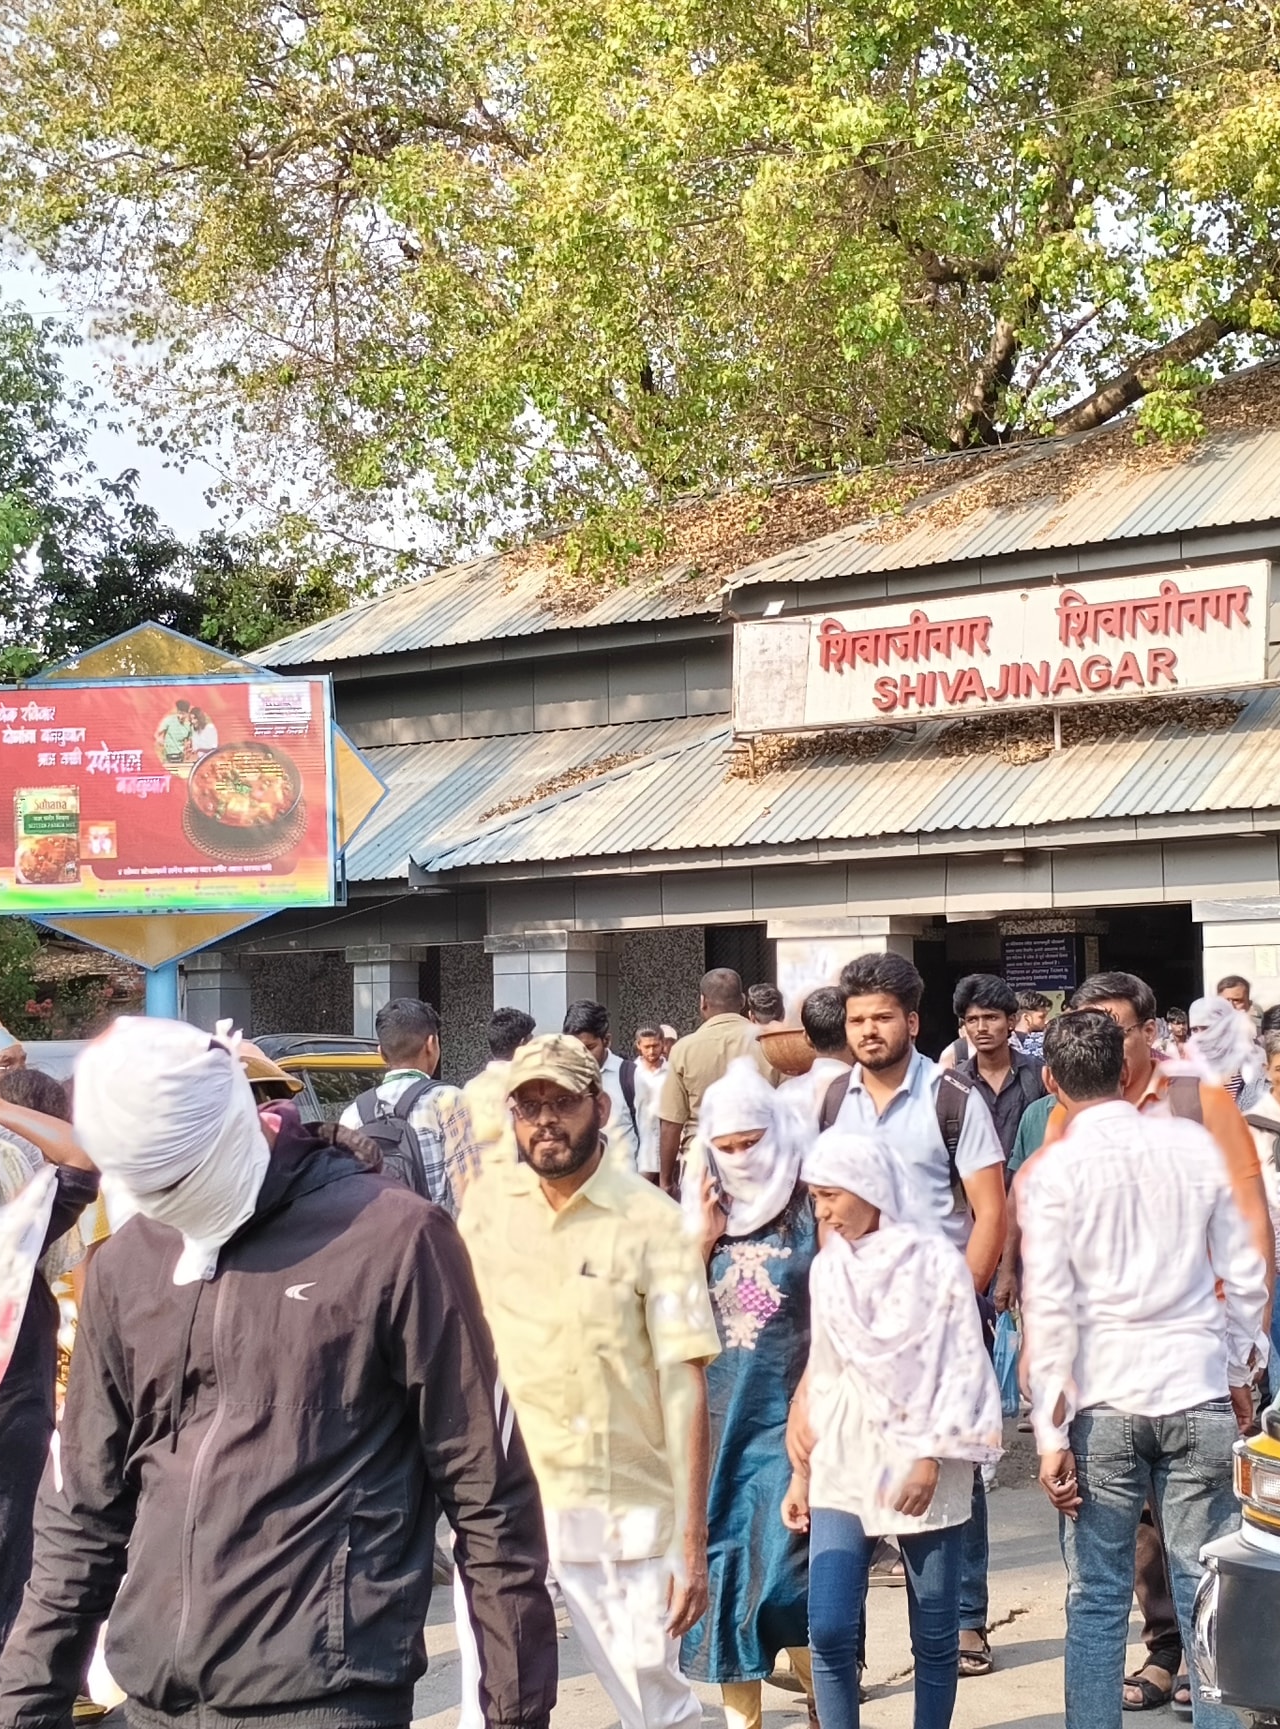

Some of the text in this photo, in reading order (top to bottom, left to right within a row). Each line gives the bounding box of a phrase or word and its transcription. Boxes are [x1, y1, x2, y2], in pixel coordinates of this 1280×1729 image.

[816, 579, 1252, 676] शिवाजीनगर शिवाजीनगर
[872, 647, 1178, 712] SHIVAJINAGAR
[34, 798, 67, 810] Suhana
